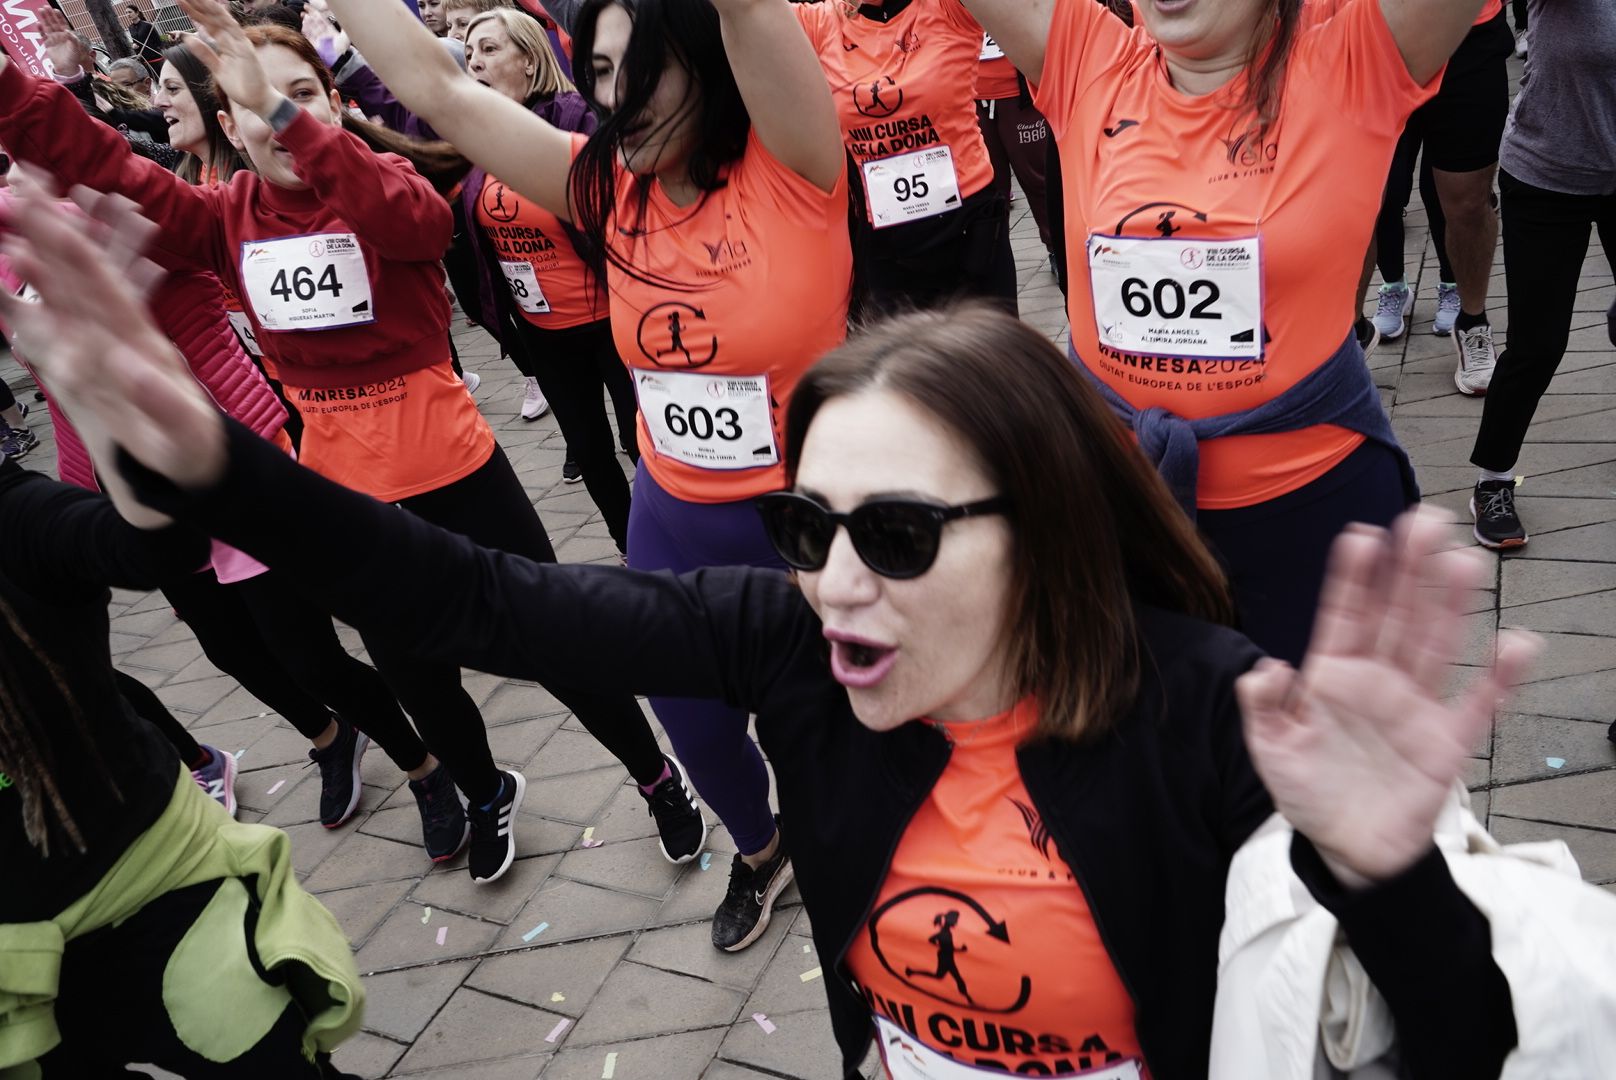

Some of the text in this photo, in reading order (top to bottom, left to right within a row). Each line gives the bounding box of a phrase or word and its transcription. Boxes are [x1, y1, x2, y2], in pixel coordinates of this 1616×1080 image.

[848, 115, 932, 141] VIII CURSA
[1019, 126, 1046, 143] 1988
[869, 142, 889, 156] LA
[890, 128, 941, 152] DONA
[894, 173, 929, 202] 95
[499, 226, 546, 240] CURSA
[513, 239, 556, 254] DONA
[269, 263, 344, 303] 464
[1121, 277, 1222, 320] 602
[1128, 374, 1183, 391] EUROPEA
[1187, 381, 1202, 391] DE
[360, 402, 371, 410] DE
[372, 392, 408, 408] L'ESPORT
[664, 403, 743, 440] 603
[927, 1012, 1109, 1056] CURSA
